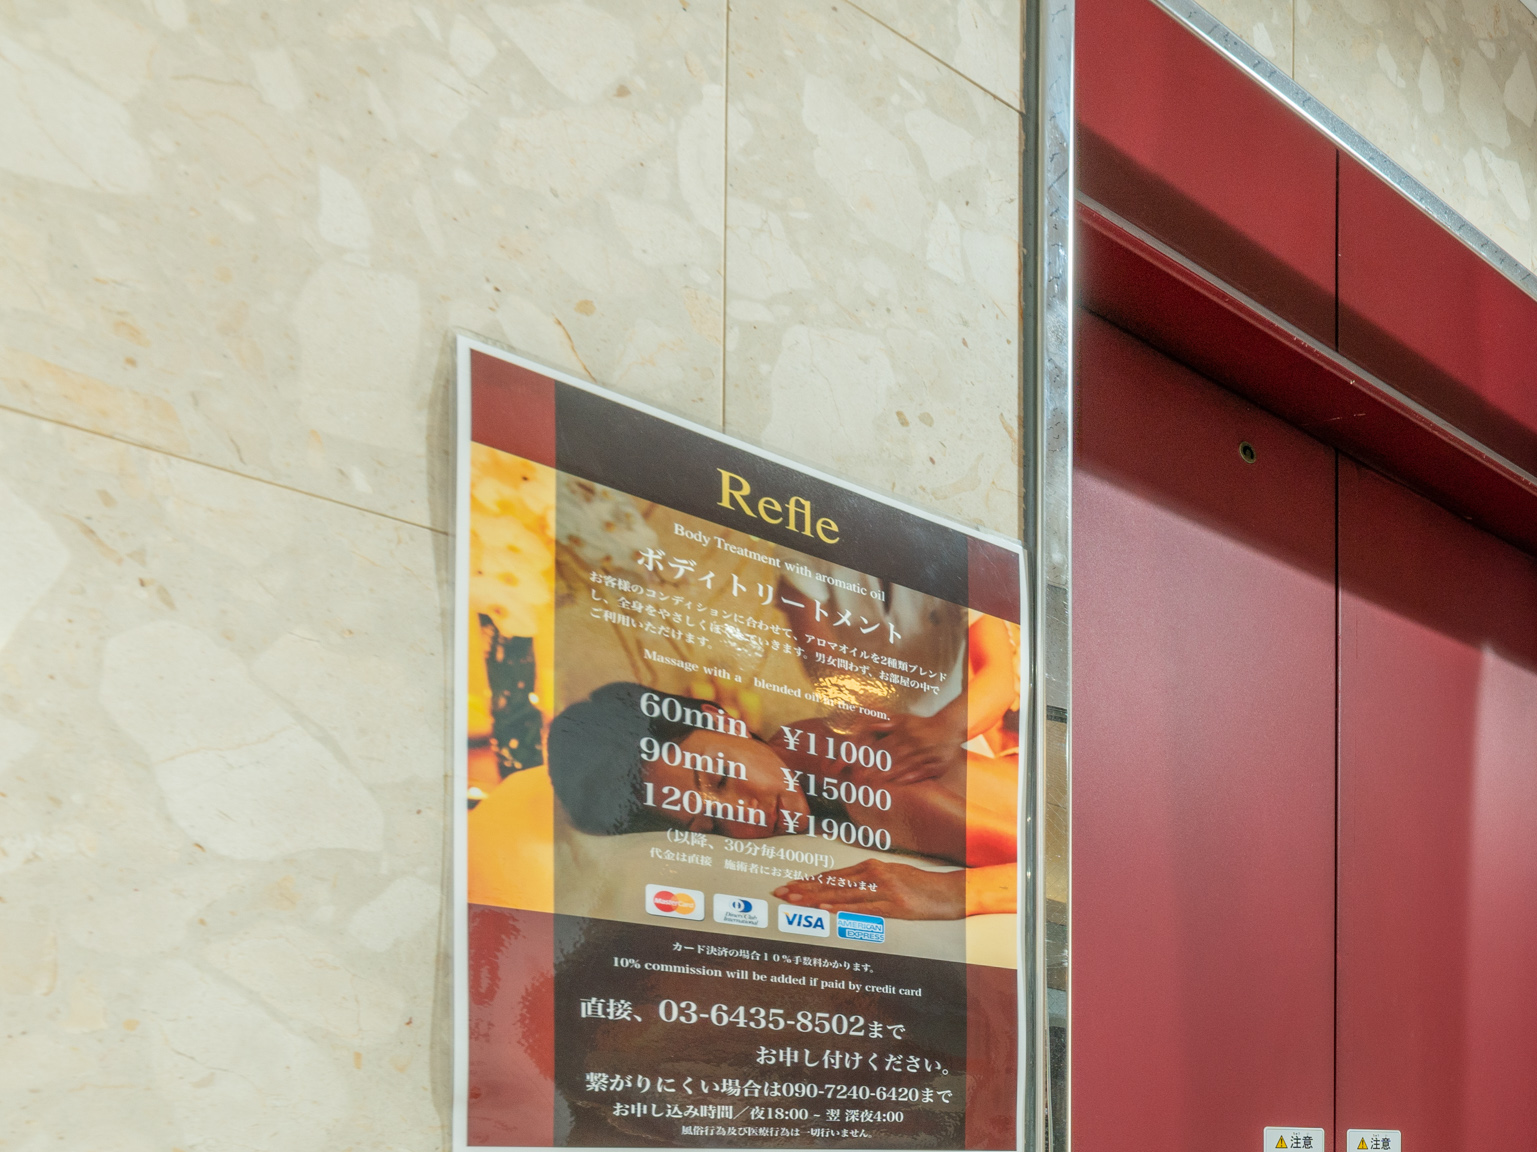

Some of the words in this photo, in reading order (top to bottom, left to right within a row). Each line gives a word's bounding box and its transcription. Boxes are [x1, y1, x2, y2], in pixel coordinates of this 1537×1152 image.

[716, 467, 841, 544] Refle
[673, 522, 711, 547] Body
[713, 535, 781, 569] Treatment
[784, 560, 813, 578] with
[815, 570, 868, 596] aromatic
[869, 588, 885, 602] oil
[637, 547, 902, 644] ボディトリートメント
[589, 607, 713, 650] ご利用いただけます。
[643, 648, 699, 672] Massage
[702, 665, 731, 681] with
[733, 674, 742, 683] a
[753, 676, 801, 698] blended
[804, 690, 820, 703] oil
[837, 697, 856, 712] the
[858, 705, 891, 721] room.
[640, 691, 749, 739] 60min
[780, 725, 892, 772] ¥11000
[639, 736, 749, 781] 90min
[780, 766, 892, 811] ¥15000
[643, 781, 768, 828] 120min
[780, 808, 892, 850] ¥19000
[649, 846, 713, 868] 代金は直接
[724, 858, 879, 893] 施術者にお支払いくださいませ
[653, 896, 696, 910] MasterCard
[782, 910, 826, 931] VISA
[837, 918, 882, 932] AMERICAN
[846, 930, 885, 942] EXPRESS
[612, 955, 641, 970] 10%
[644, 960, 723, 978] commission
[726, 968, 749, 981] will
[752, 970, 768, 982] be
[769, 972, 807, 986] added
[809, 976, 819, 987] if
[820, 977, 845, 991] paid
[848, 979, 863, 993] by
[865, 981, 896, 996] credit
[898, 985, 922, 998] card
[755, 1046, 950, 1077] お申し付けください。
[584, 1071, 953, 1105] 繋がりにくい場合は090-7240-6420まで
[844, 1108, 904, 1124] 深夜4:00
[1290, 1135, 1314, 1149] 注意
[1370, 1137, 1391, 1150] 注意
